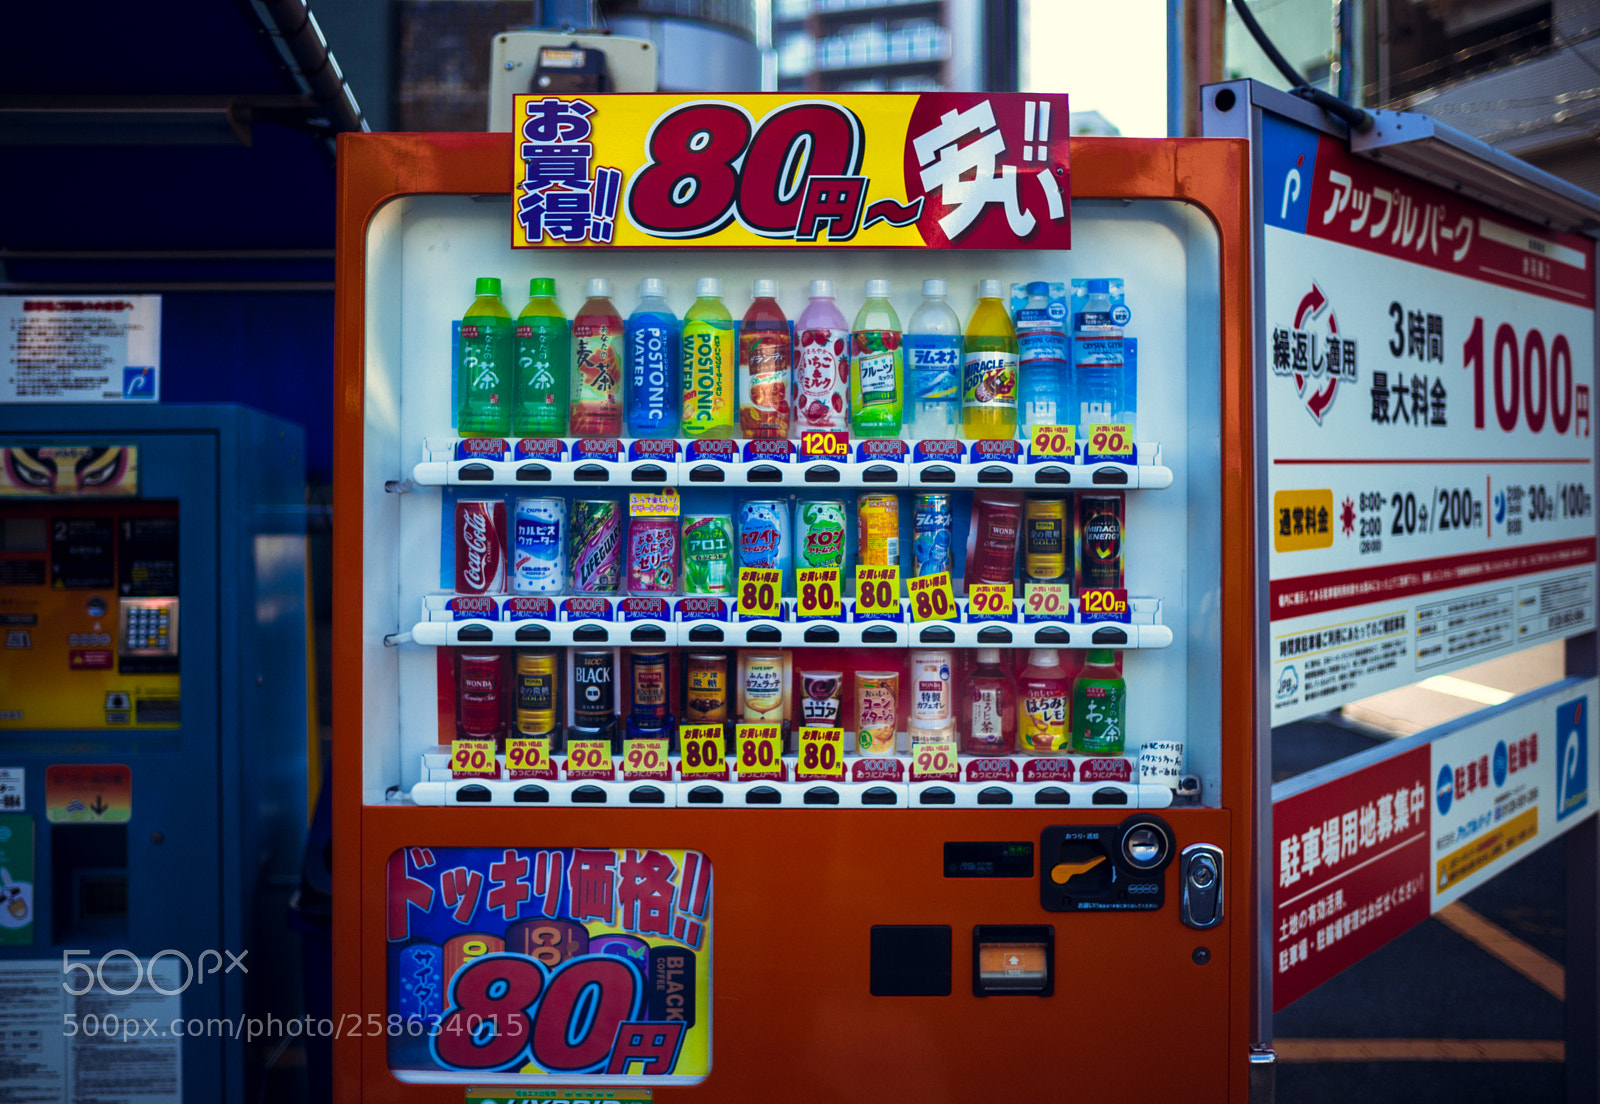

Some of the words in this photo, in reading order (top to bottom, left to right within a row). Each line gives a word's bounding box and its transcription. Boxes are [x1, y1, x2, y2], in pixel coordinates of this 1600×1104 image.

[1322, 168, 1474, 263] アップルパーク
[1388, 300, 1444, 365] 3時間
[633, 329, 645, 387] WATER
[1272, 327, 1357, 378] 繰返し適用
[683, 335, 695, 391] WATER
[648, 327, 665, 420] POSTONIC
[697, 333, 715, 422] POSTONIC
[812, 369, 822, 378] &
[861, 363, 893, 379] フルーツ
[1462, 315, 1590, 440] 1000円
[803, 377, 832, 390] ミルク
[1370, 370, 1447, 428] 最大料金
[468, 439, 503, 453] 100円
[523, 439, 557, 453] 100円
[583, 439, 618, 453] 100円
[639, 439, 674, 453] 100円
[698, 439, 732, 453] 100円
[754, 439, 788, 453] 100円
[803, 433, 848, 454] 120円
[868, 440, 902, 454] 100円
[924, 440, 958, 454] 100円
[981, 440, 1015, 454] 100円
[1278, 504, 1330, 537] 通常料金
[54, 522, 67, 541] 2
[518, 525, 556, 537] カルピス
[740, 528, 780, 546] ホワイト
[806, 528, 844, 547] メロン
[518, 536, 556, 547] ウォーター
[689, 538, 727, 552] アロエ
[638, 554, 670, 571] ゼリー
[741, 571, 780, 583] お買い得品
[799, 571, 837, 582] お買い得品
[858, 569, 896, 580] お買い得品
[910, 574, 948, 592] お買い得品
[456, 598, 491, 610] 100円
[514, 598, 549, 610] 100円
[571, 598, 605, 610] 100円
[627, 599, 662, 611] 100円
[684, 599, 719, 611] 100円
[1081, 591, 1126, 612] 120円
[575, 666, 611, 684] BLACK
[749, 672, 777, 680] ふんわり
[465, 679, 493, 688] WONDA
[692, 678, 719, 688] 微糖
[638, 694, 663, 702] SHOT
[865, 690, 890, 698] おいしい
[921, 692, 942, 703] 特製
[863, 698, 891, 710] コーン
[916, 702, 945, 710] カフェオレ
[804, 706, 837, 719] ココア
[860, 710, 895, 724] ポタージュ
[980, 690, 995, 735] ほうじ茶
[684, 728, 722, 739] お買い得品
[739, 728, 777, 739] お買い得品
[802, 730, 841, 742] お買い得品
[863, 759, 897, 772] 100円
[976, 759, 1010, 772] 100円
[1034, 759, 1068, 772] 100円
[1091, 759, 1124, 772] 100円
[1453, 753, 1490, 801] 駐車場
[1279, 779, 1425, 889] 駐車場用地募集中
[387, 847, 712, 949] ドッキリ価格!!
[657, 957, 665, 992] COFFEE
[412, 949, 436, 1020] サイダー
[665, 955, 685, 1022] BLACK
[430, 952, 688, 1076] 80円
